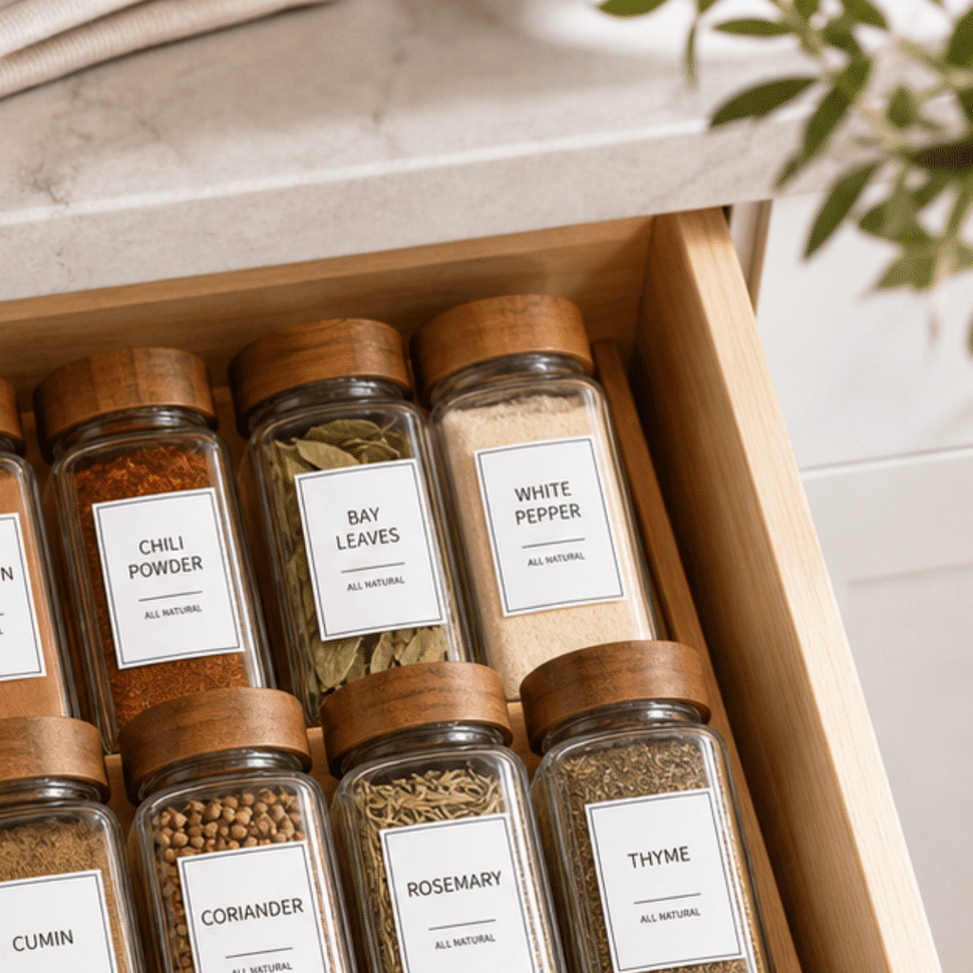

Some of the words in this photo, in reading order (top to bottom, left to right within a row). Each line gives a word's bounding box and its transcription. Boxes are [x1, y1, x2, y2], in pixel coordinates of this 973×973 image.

[514, 481, 572, 503] WHITE
[347, 507, 380, 526] BAY
[515, 503, 582, 526] PEPPER
[138, 535, 184, 556] CHILI
[335, 526, 401, 551] LEAVES
[128, 555, 204, 580] POWDER
[527, 557, 544, 567] ALL
[545, 553, 584, 564] NATURAL
[347, 581, 363, 591] ALL
[364, 576, 405, 588] NATURAL
[144, 610, 161, 620] ALL
[161, 605, 202, 617] NATURAL
[627, 845, 691, 869] THYME
[406, 870, 502, 898] ROSEMARY
[200, 897, 304, 927] CORIANDER
[640, 913, 658, 923] ALL
[658, 908, 701, 921] NATURAL
[12, 929, 74, 953] CUMIN
[435, 940, 452, 950] ALL
[452, 934, 496, 947] NATURAL
